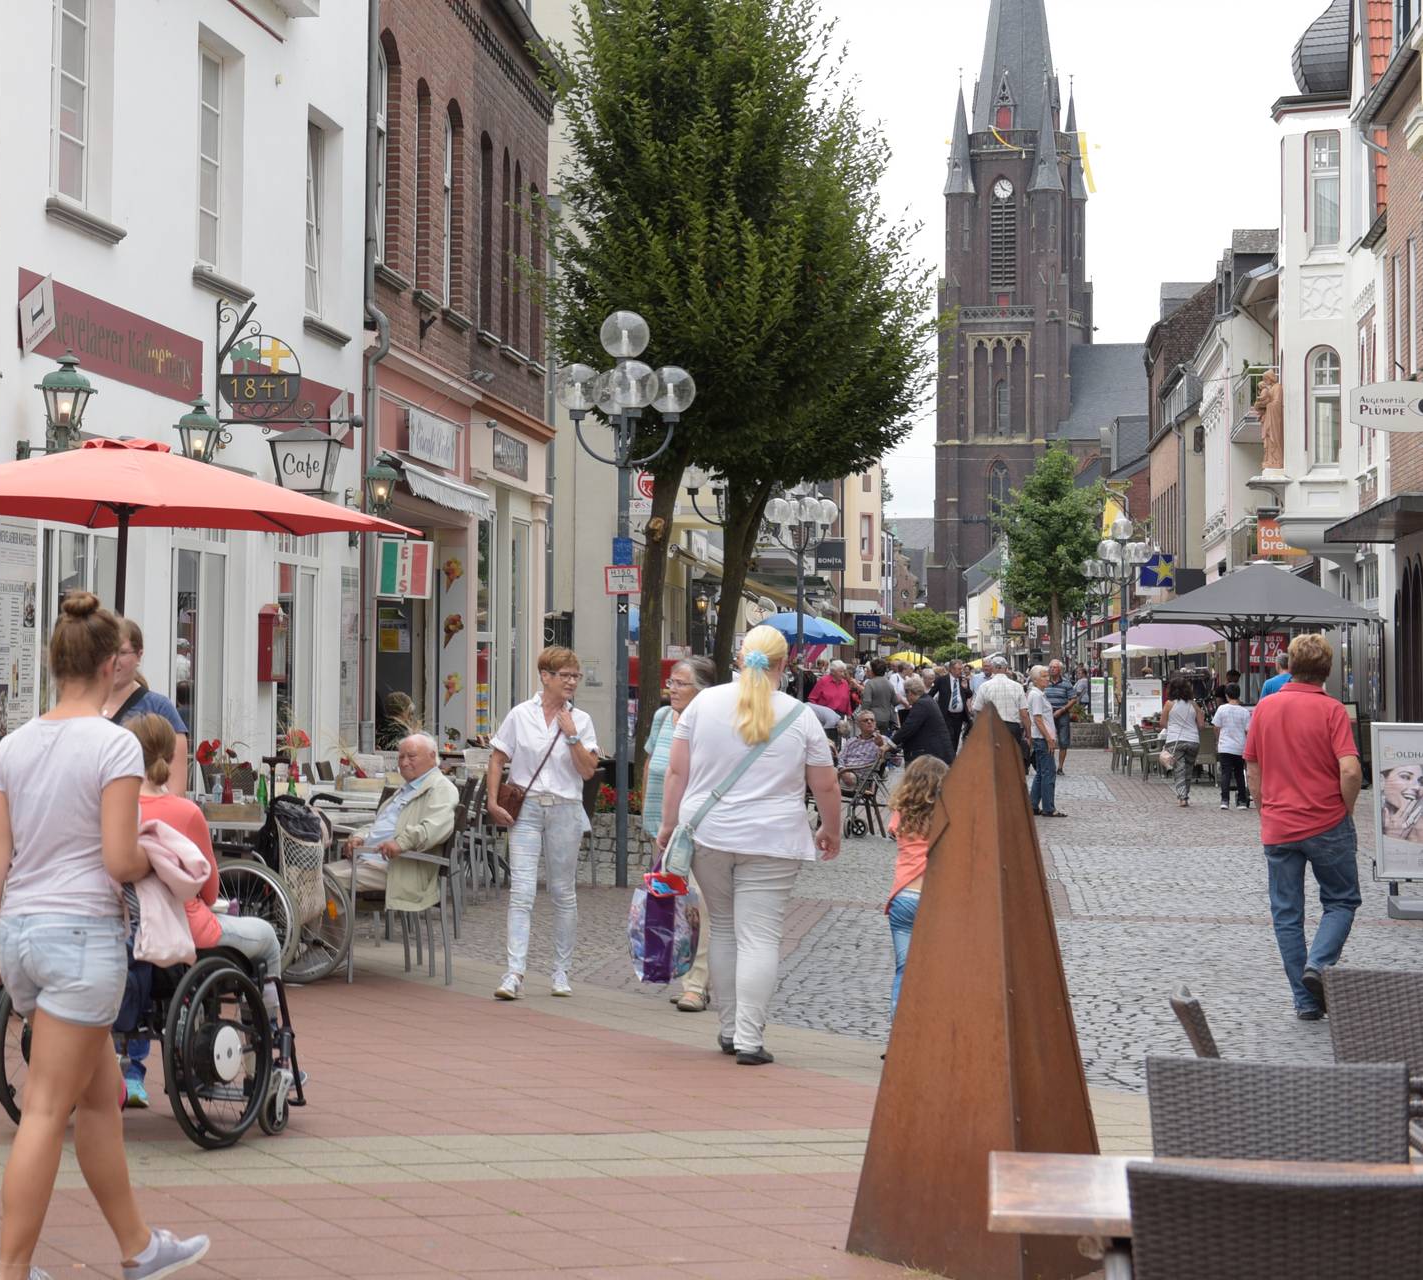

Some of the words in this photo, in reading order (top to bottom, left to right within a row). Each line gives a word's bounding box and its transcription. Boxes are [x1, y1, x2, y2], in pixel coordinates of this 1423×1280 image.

[230, 378, 289, 399] 1841
[282, 452, 320, 479] Cafe
[1260, 526, 1281, 538] fot
[398, 546, 409, 593] EIS
